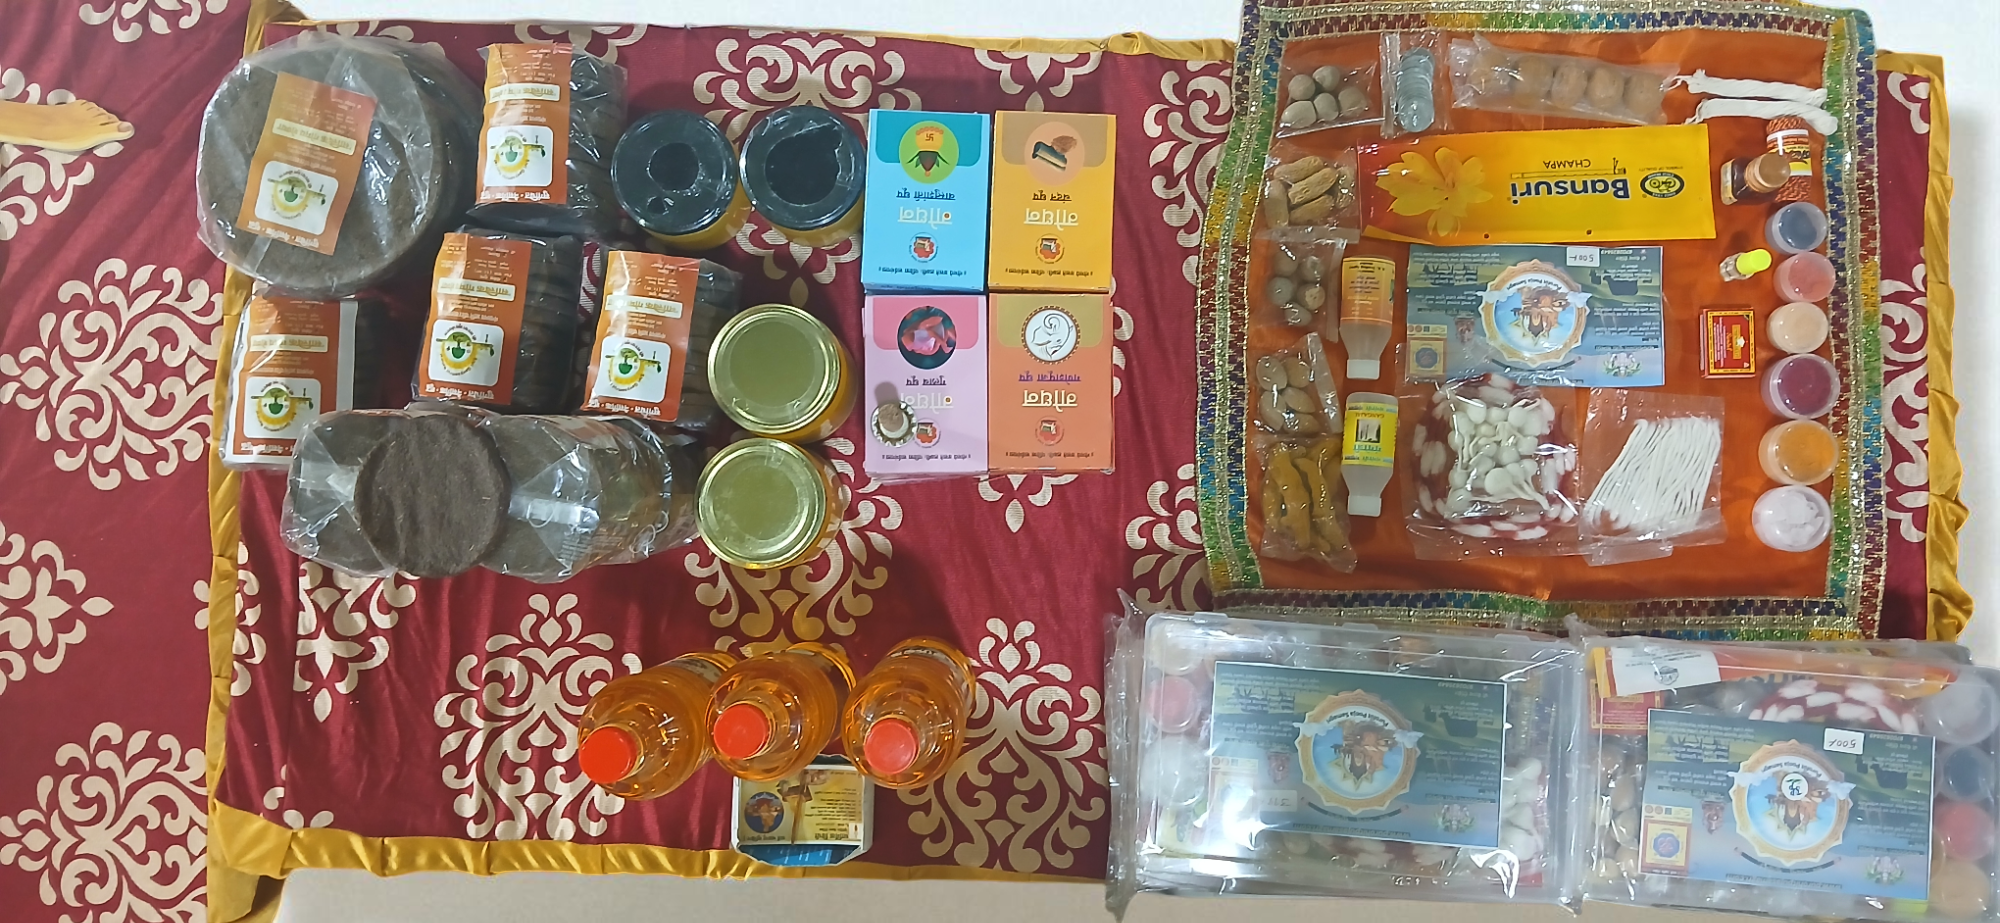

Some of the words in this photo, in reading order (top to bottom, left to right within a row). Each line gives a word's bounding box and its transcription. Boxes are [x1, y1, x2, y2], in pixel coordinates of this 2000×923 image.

[1542, 158, 1592, 170] CHAMPA
[525, 190, 550, 201] सुगंधित
[896, 188, 910, 198] धूप
[914, 188, 956, 201] वास्तुशांती
[1032, 190, 1046, 201] धूप
[1510, 178, 1630, 205] Bansuri
[1050, 192, 1072, 204] चंदन
[897, 206, 952, 230] गोधन
[1024, 208, 1078, 231] गोधन
[625, 300, 644, 310] गोम
[906, 376, 919, 386] धूप
[922, 376, 946, 386] गुलाब
[1018, 370, 1033, 382] धूप
[1037, 371, 1081, 385] गणेशपूजा
[468, 390, 494, 400] सुगंधित
[900, 392, 954, 414] गोधन
[1022, 390, 1078, 413] गोधन
[634, 406, 661, 418] सुगंधित
